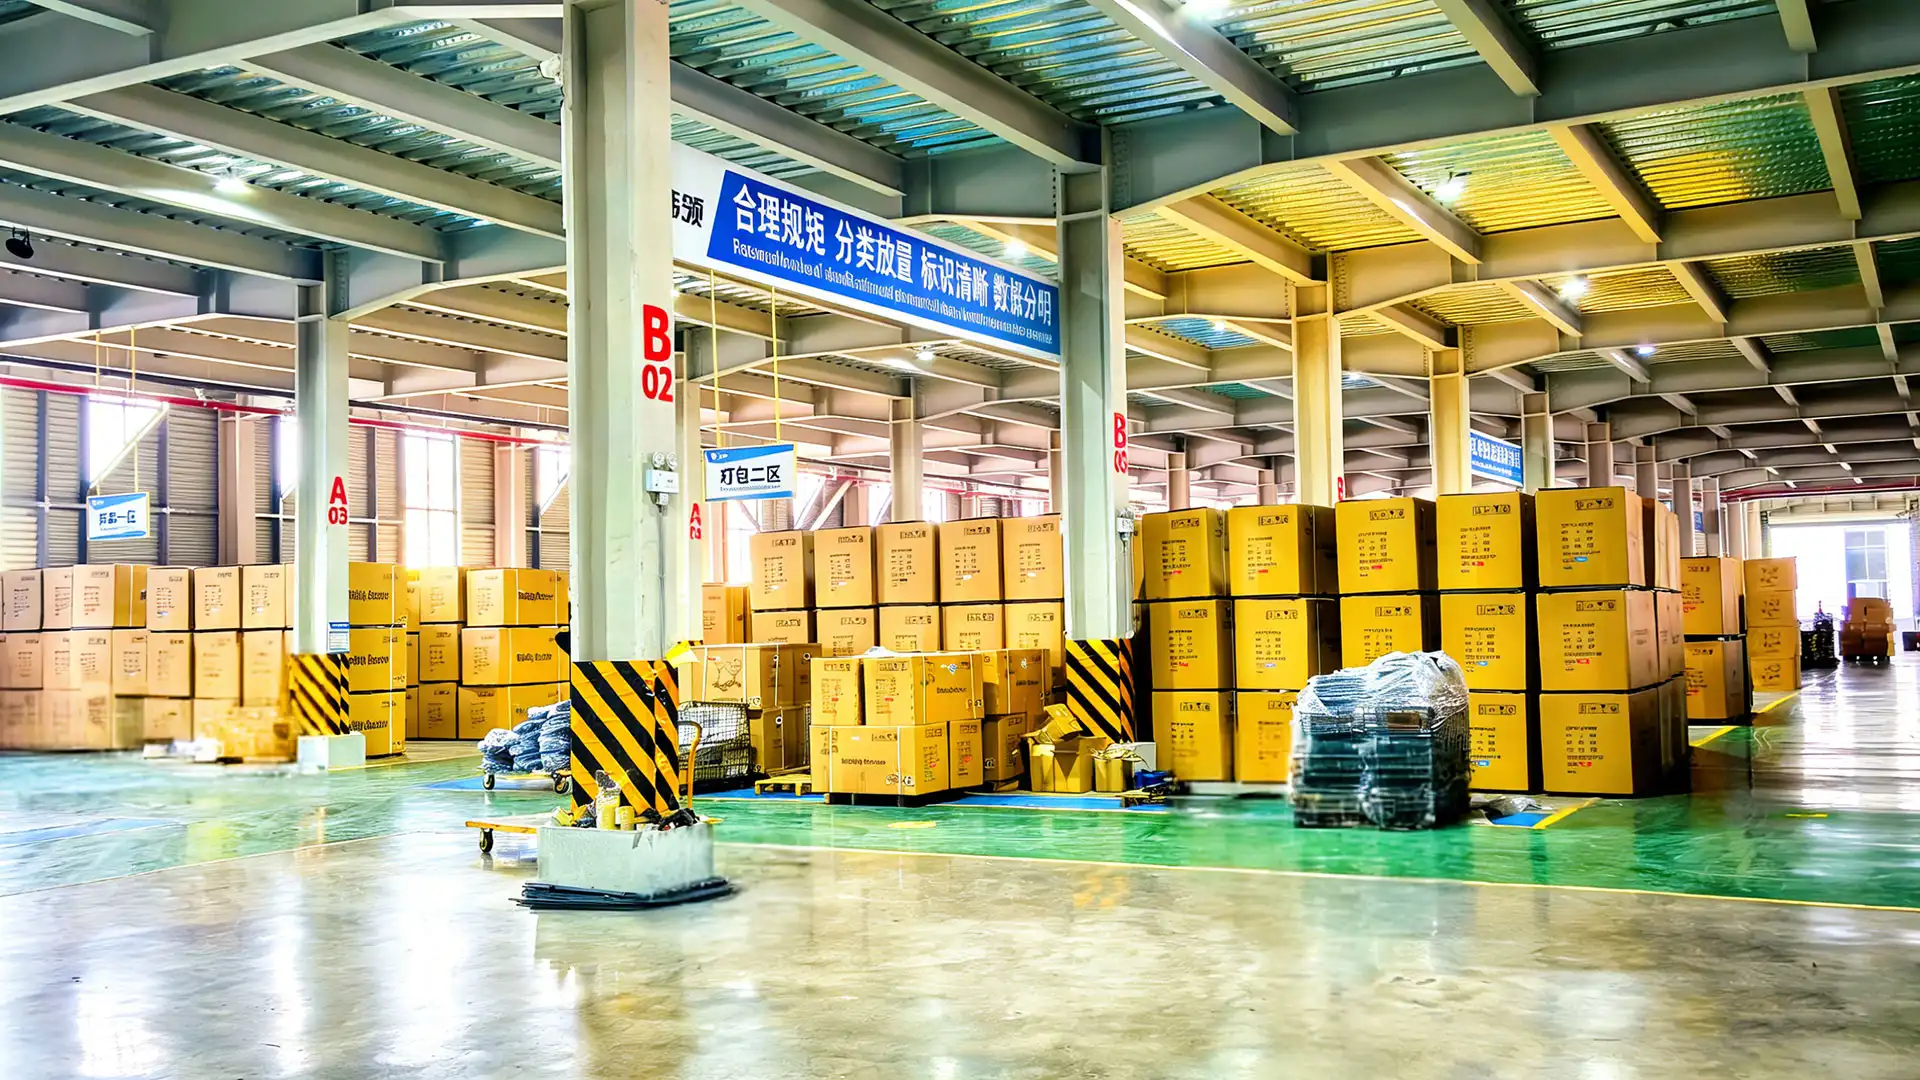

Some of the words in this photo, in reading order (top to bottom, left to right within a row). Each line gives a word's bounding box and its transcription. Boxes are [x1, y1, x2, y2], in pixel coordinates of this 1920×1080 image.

[733, 183, 826, 256] 合理规矩
[835, 219, 913, 283] 分类放置
[921, 246, 989, 308] 标识清晰
[993, 272, 1052, 326] 数据分明
[642, 304, 671, 362] B
[642, 364, 673, 403] 02
[1113, 412, 1127, 449] B
[329, 476, 347, 504] A
[328, 506, 348, 525] 03
